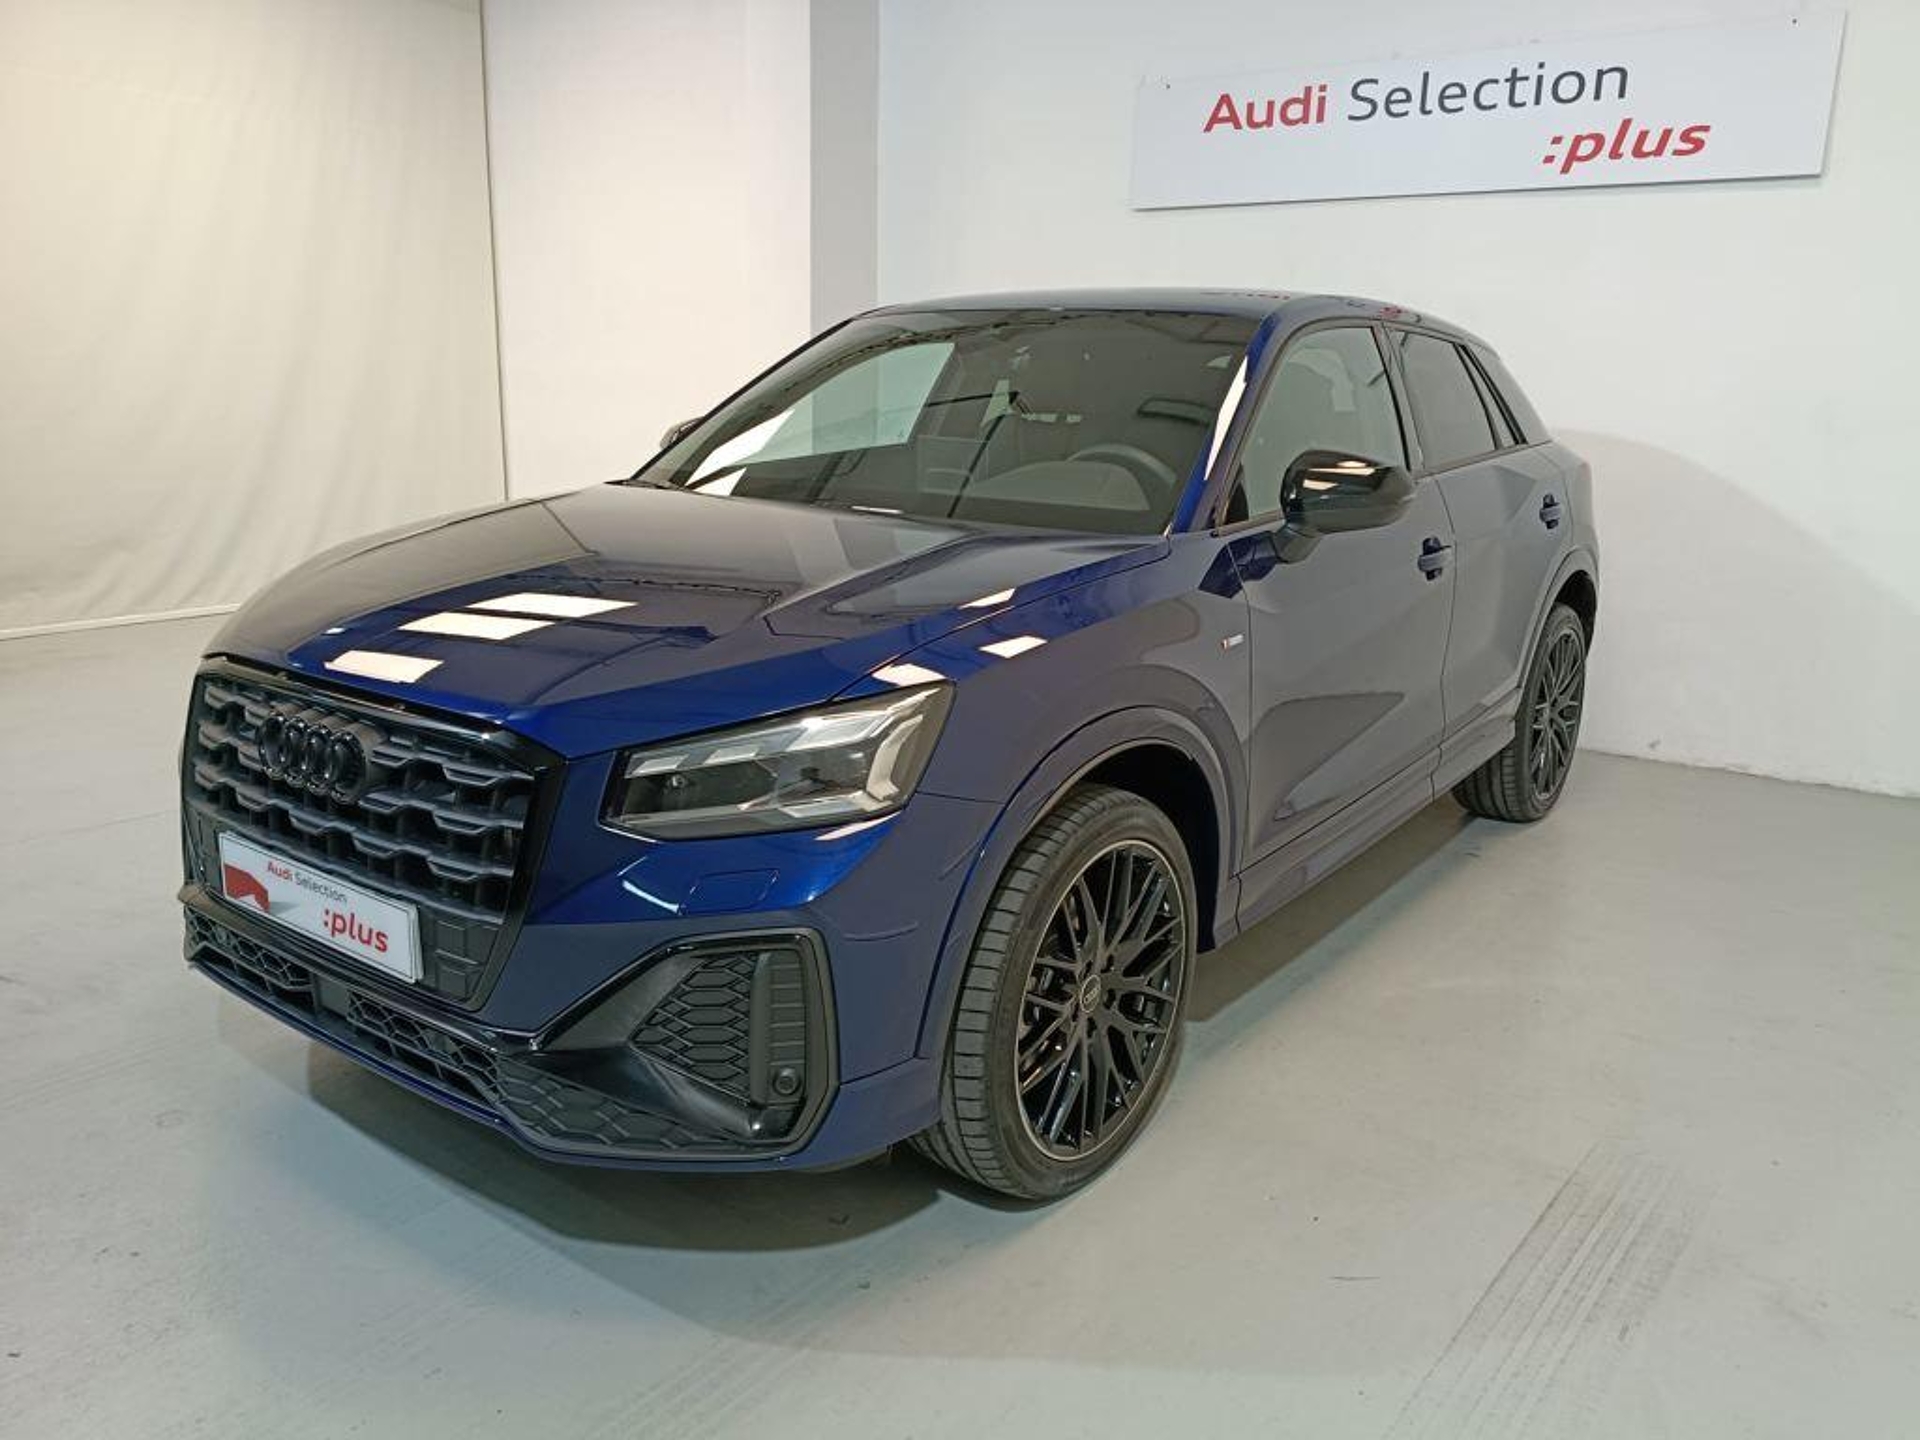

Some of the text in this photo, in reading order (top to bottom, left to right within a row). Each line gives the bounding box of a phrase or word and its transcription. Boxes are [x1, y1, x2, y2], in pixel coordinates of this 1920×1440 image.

[1203, 61, 1629, 132] Audi Selection
[1542, 118, 1711, 174] :plus
[266, 860, 348, 904] Audi Selection
[322, 907, 389, 953] :plus
